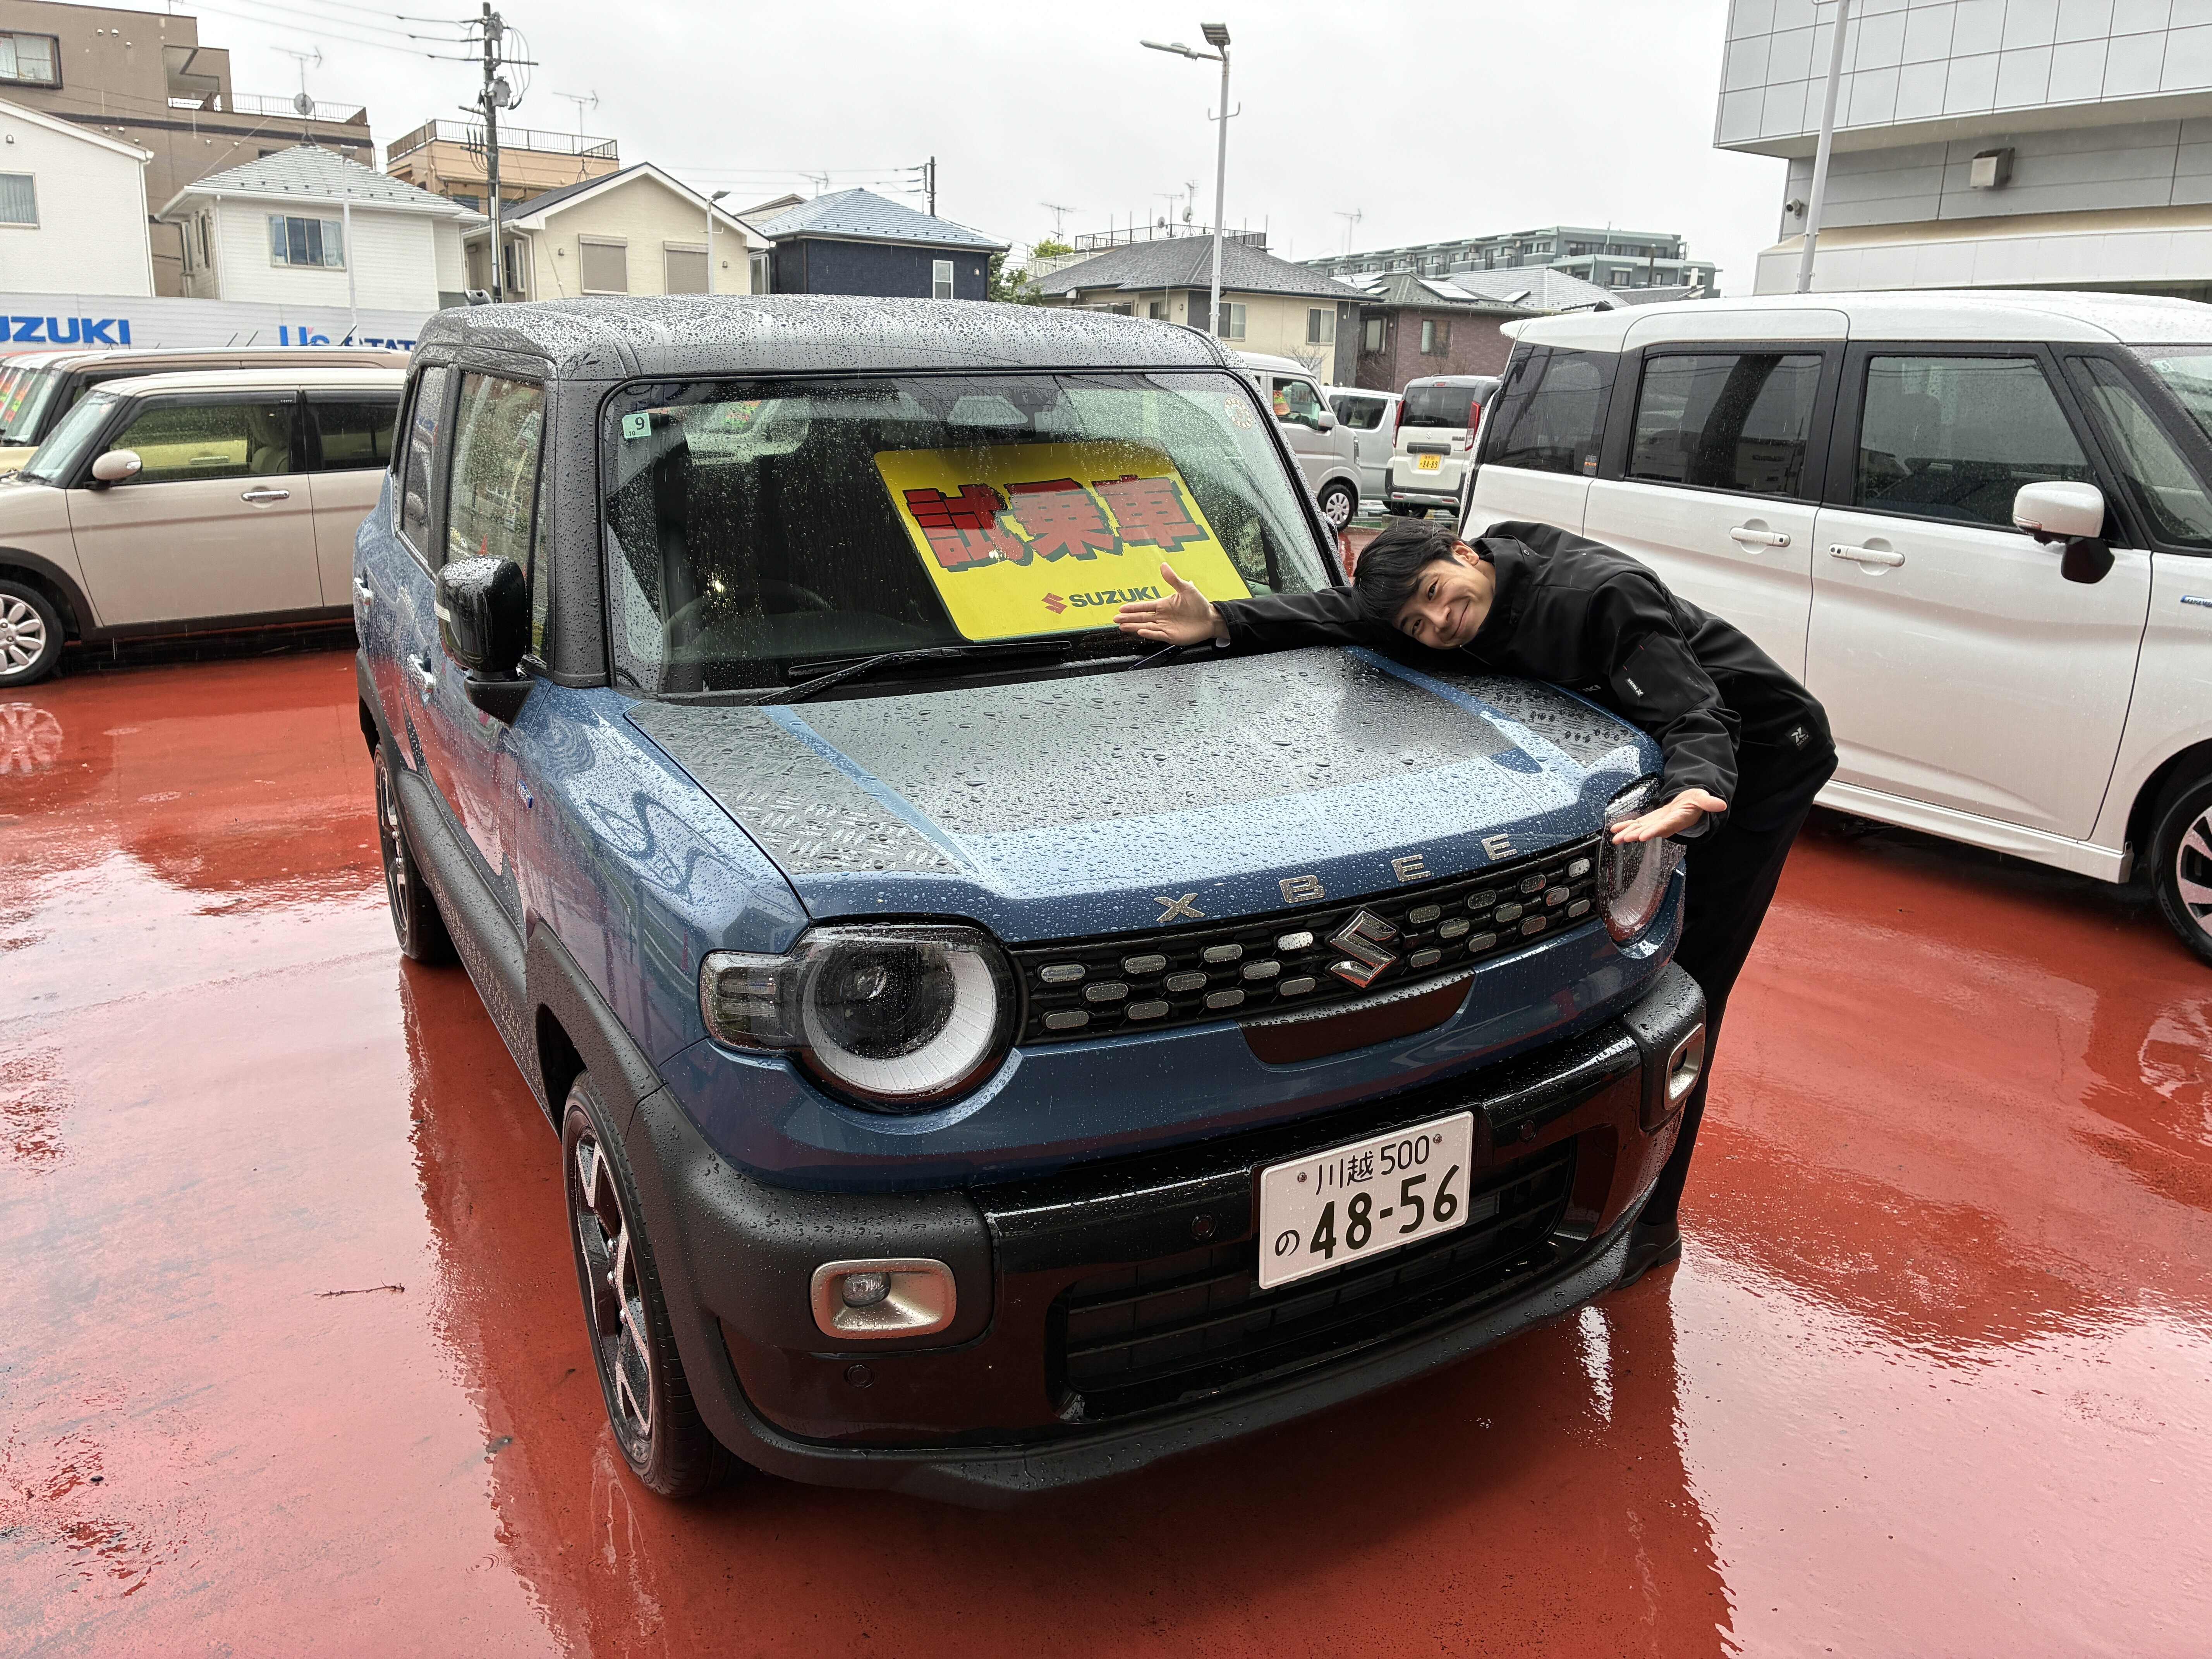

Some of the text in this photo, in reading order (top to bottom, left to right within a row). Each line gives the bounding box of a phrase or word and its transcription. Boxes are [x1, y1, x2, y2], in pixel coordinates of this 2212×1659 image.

[635, 417, 645, 430] 9
[902, 475, 1210, 572] 試乗車
[1068, 586, 1162, 607] SUZUKI
[1316, 1135, 1429, 1195] 川越 500
[1275, 1164, 1460, 1259] の 48-56
